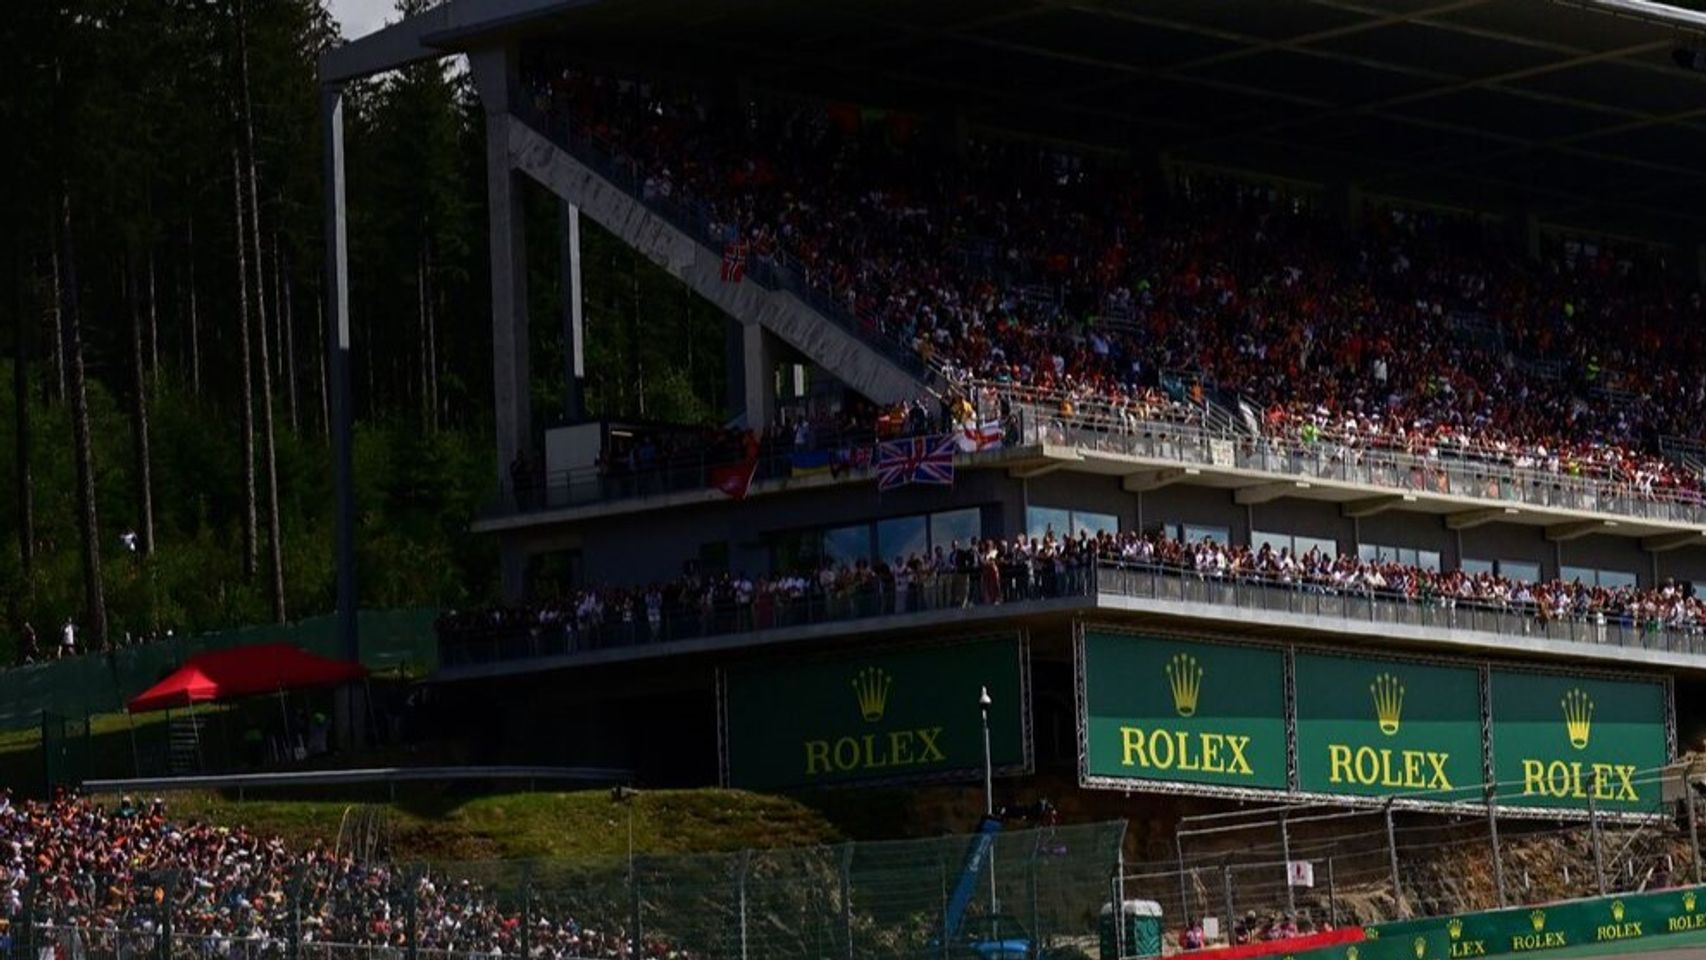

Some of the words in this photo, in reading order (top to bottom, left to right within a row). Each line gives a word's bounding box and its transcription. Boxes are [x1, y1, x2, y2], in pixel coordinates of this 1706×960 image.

[804, 727, 946, 775] ROLEX
[1120, 726, 1254, 775] ROLEX
[1328, 744, 1453, 791] ROLEX
[1522, 759, 1640, 801] ROLEX
[1513, 931, 1567, 951] ROLEX
[1597, 921, 1643, 941] ROLEX
